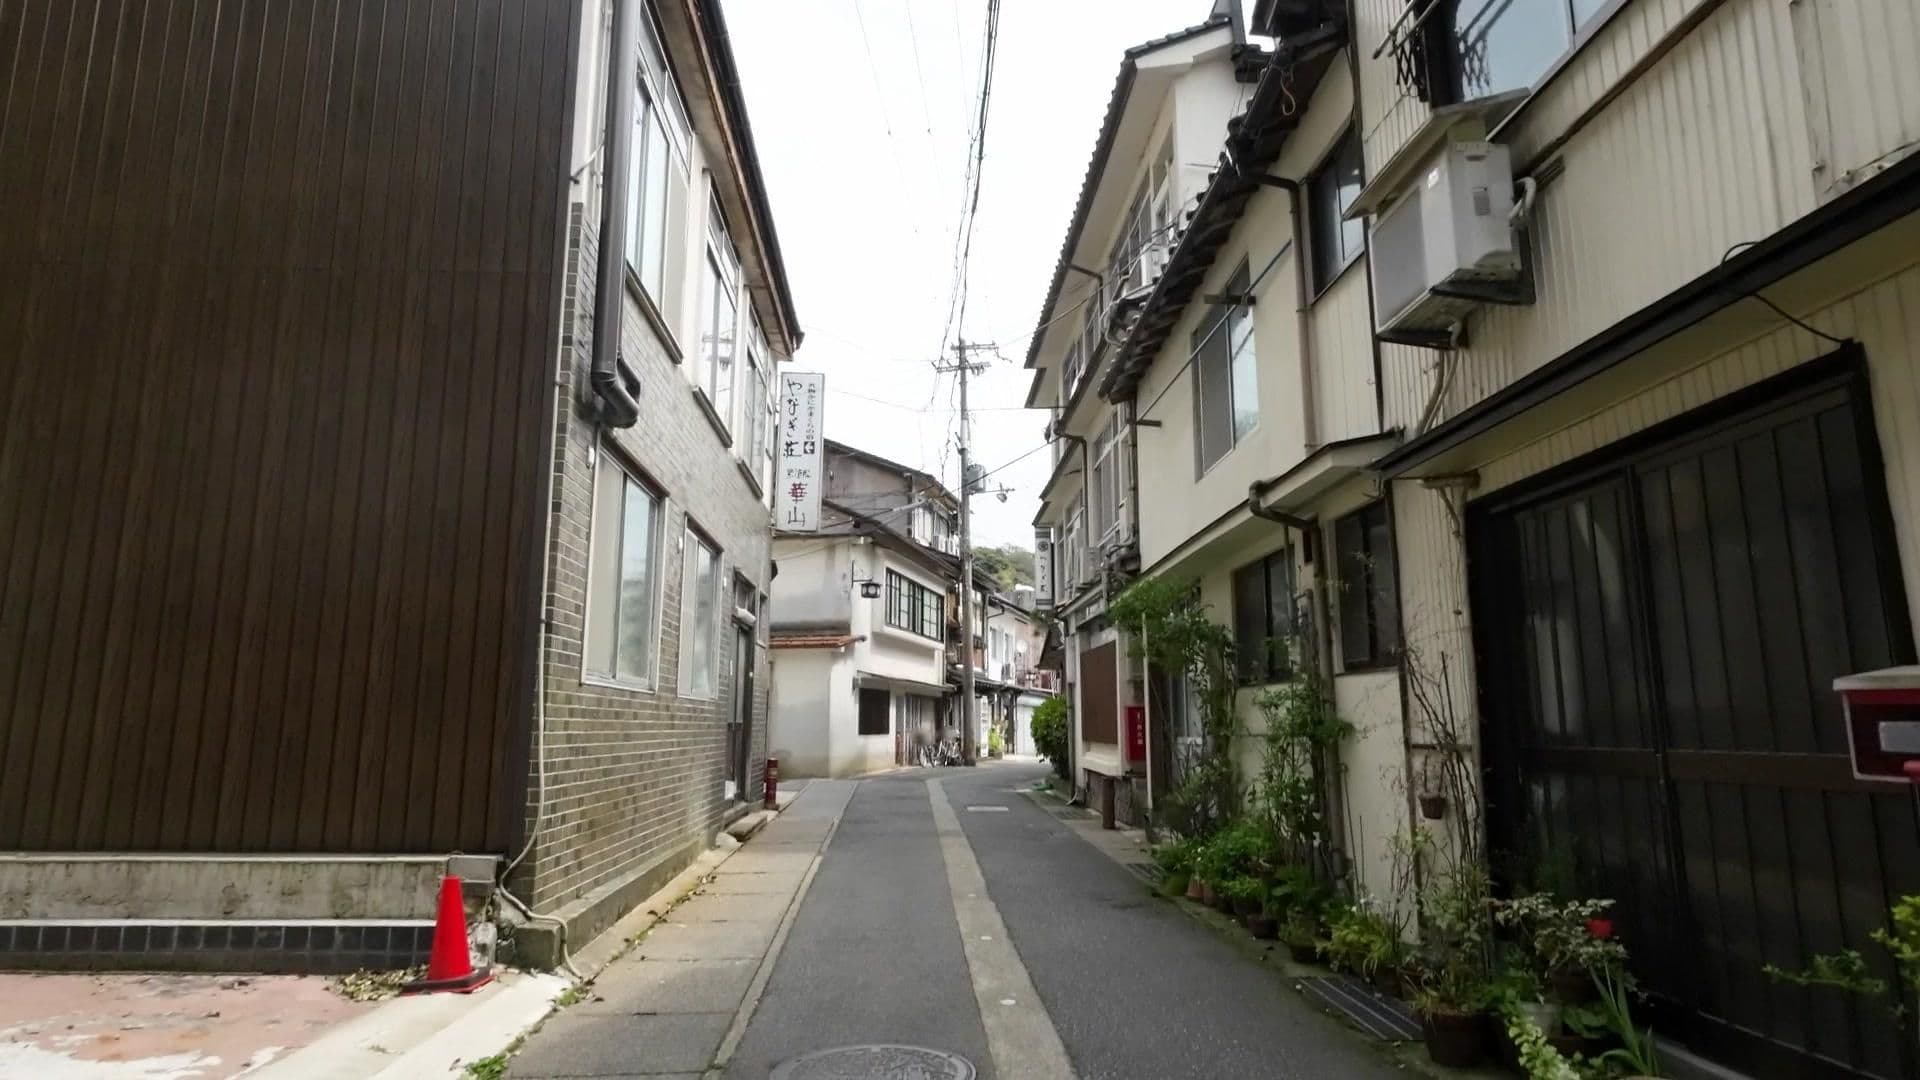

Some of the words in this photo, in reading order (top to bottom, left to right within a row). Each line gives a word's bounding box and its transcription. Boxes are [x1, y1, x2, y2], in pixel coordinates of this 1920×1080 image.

[783, 379, 803, 458] やなぎ荘
[788, 482, 808, 527] 華山
